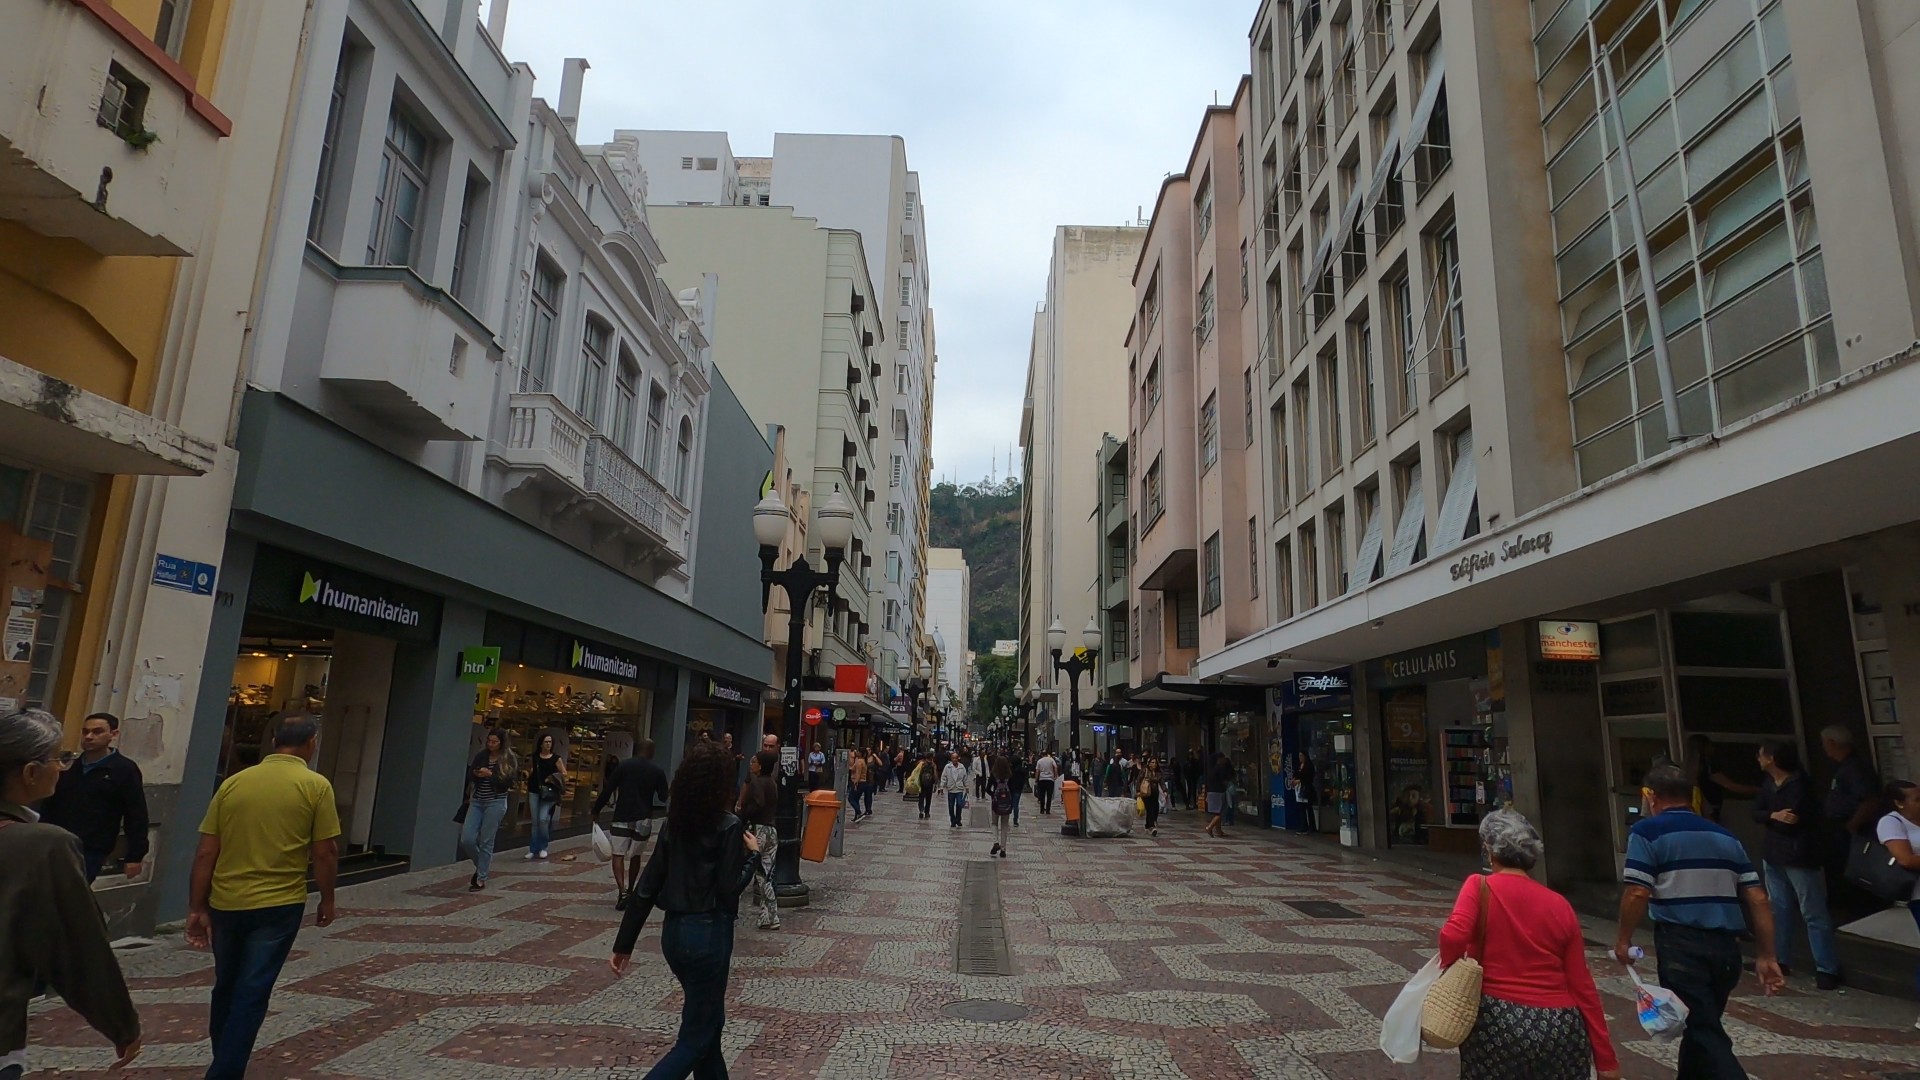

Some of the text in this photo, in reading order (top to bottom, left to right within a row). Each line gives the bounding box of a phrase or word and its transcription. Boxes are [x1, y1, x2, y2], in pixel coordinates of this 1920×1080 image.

[158, 559, 176, 570] Rua
[322, 582, 419, 626] humanitarian
[1541, 640, 1597, 648] manchester
[464, 661, 485, 673] htn
[583, 647, 637, 679] humanitarian
[1392, 649, 1457, 678] CELULARIS
[1297, 675, 1349, 691] Graffite
[1401, 722, 1412, 737] 9
